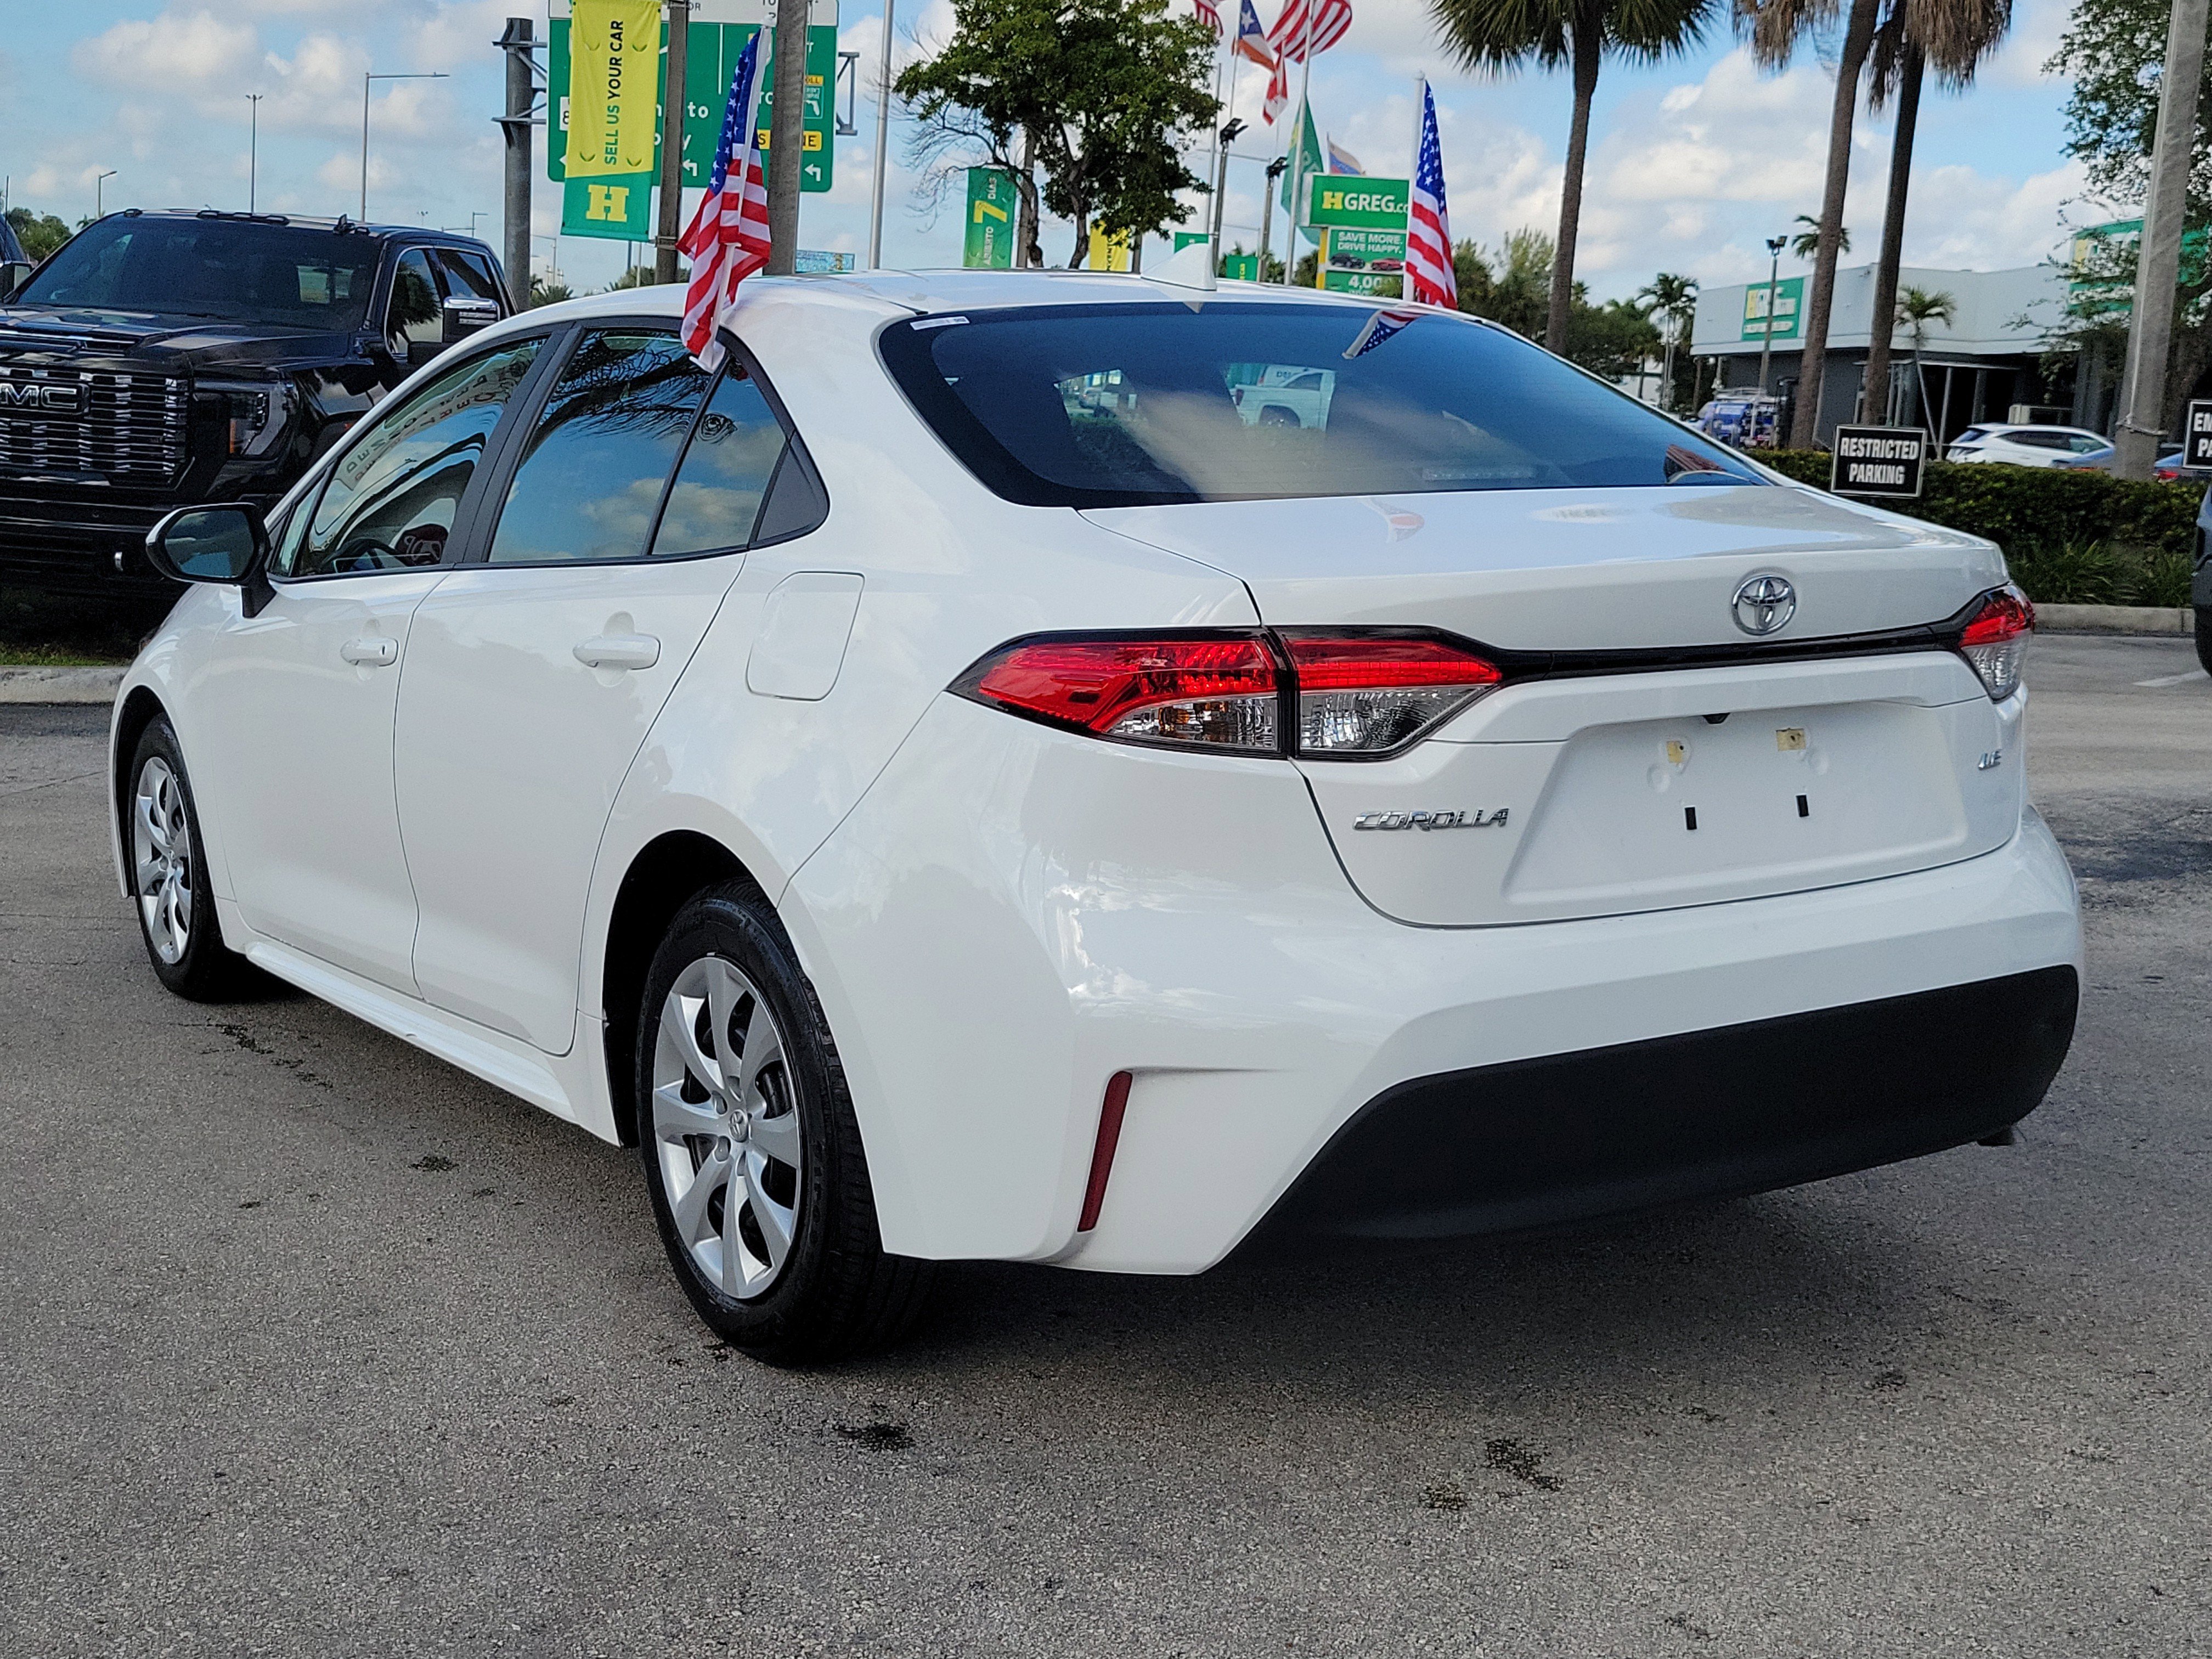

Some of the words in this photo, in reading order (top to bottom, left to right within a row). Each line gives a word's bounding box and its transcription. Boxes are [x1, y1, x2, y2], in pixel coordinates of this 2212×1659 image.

[610, 20, 624, 52] CAR
[607, 57, 623, 100] YOUR
[606, 104, 620, 125] US
[687, 101, 709, 119] to
[605, 129, 619, 165] SELL
[586, 184, 630, 223] H
[973, 200, 1007, 223] 7
[1338, 242, 1365, 251] DRIVE
[1367, 244, 1402, 254] HAPPY.
[1339, 231, 1365, 242] SAVE
[1368, 233, 1403, 245] MORE.
[1840, 437, 1920, 460] RESTRICTED
[1849, 463, 1905, 484] PARKING
[1978, 750, 2001, 771] LE
[1352, 808, 1509, 832] COROLLA
